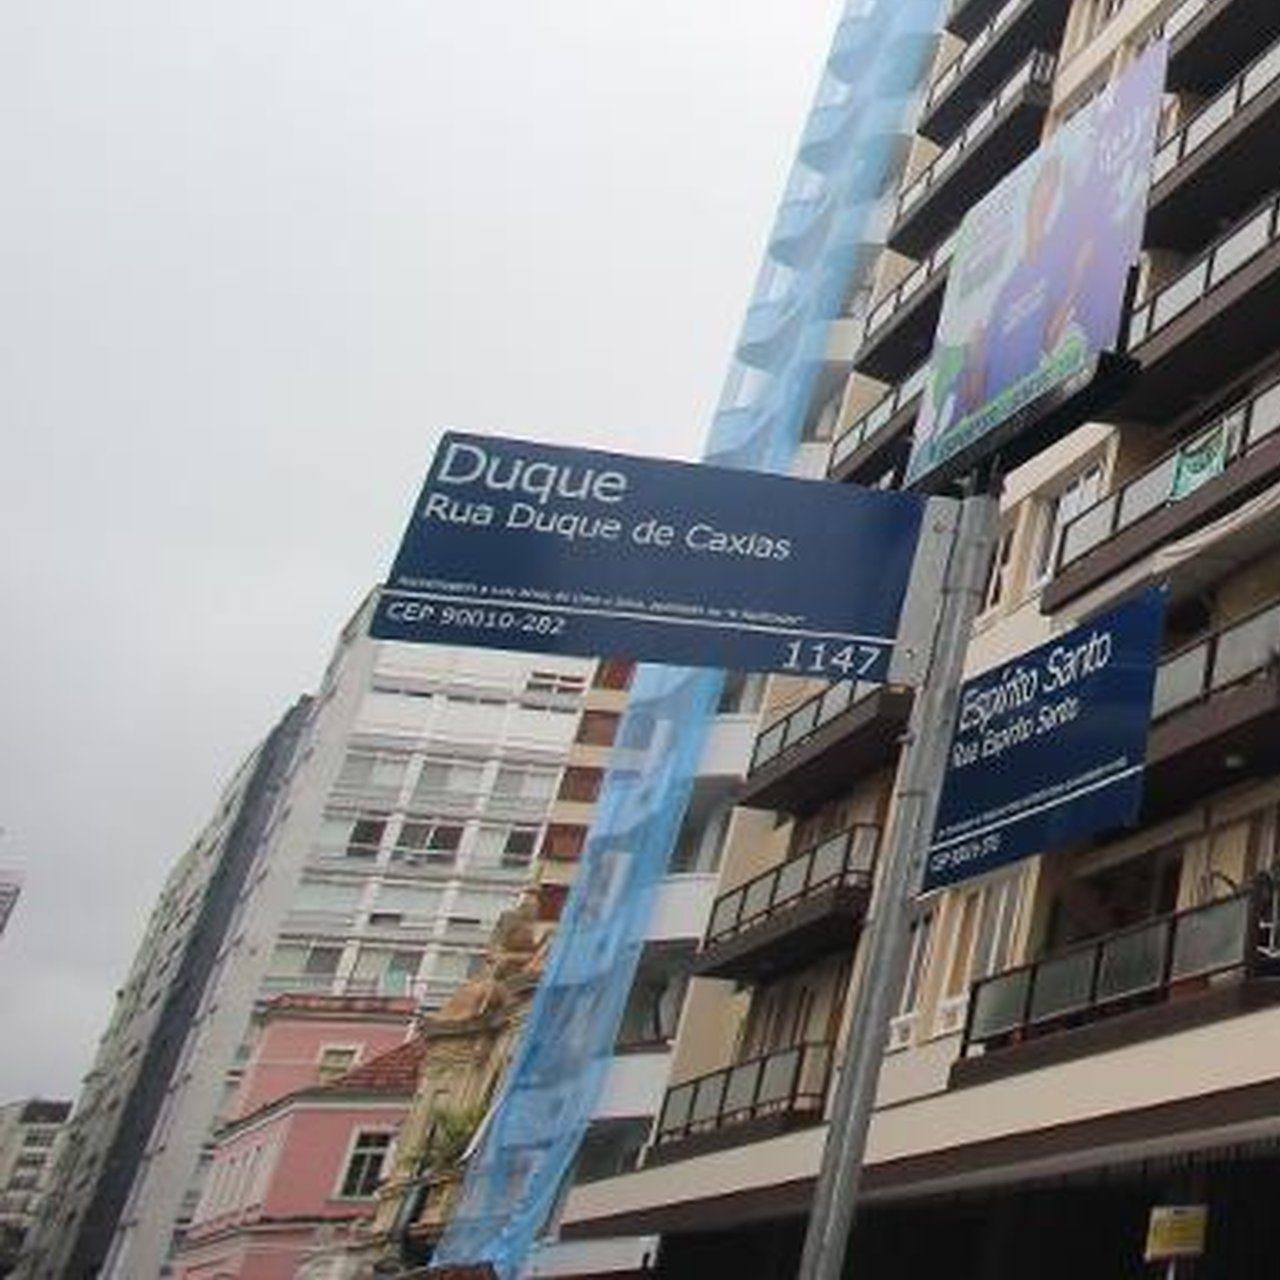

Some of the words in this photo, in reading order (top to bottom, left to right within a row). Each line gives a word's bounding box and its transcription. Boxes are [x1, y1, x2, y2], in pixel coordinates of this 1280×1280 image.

[437, 442, 628, 504] Duque
[424, 493, 494, 524] Rua
[506, 503, 622, 541] Duque
[632, 519, 675, 546] de
[685, 523, 792, 560] Caxias
[386, 601, 434, 621] CEP
[782, 640, 882, 675] 1147
[958, 666, 1038, 733] Espírito
[1042, 630, 1112, 693] Santo
